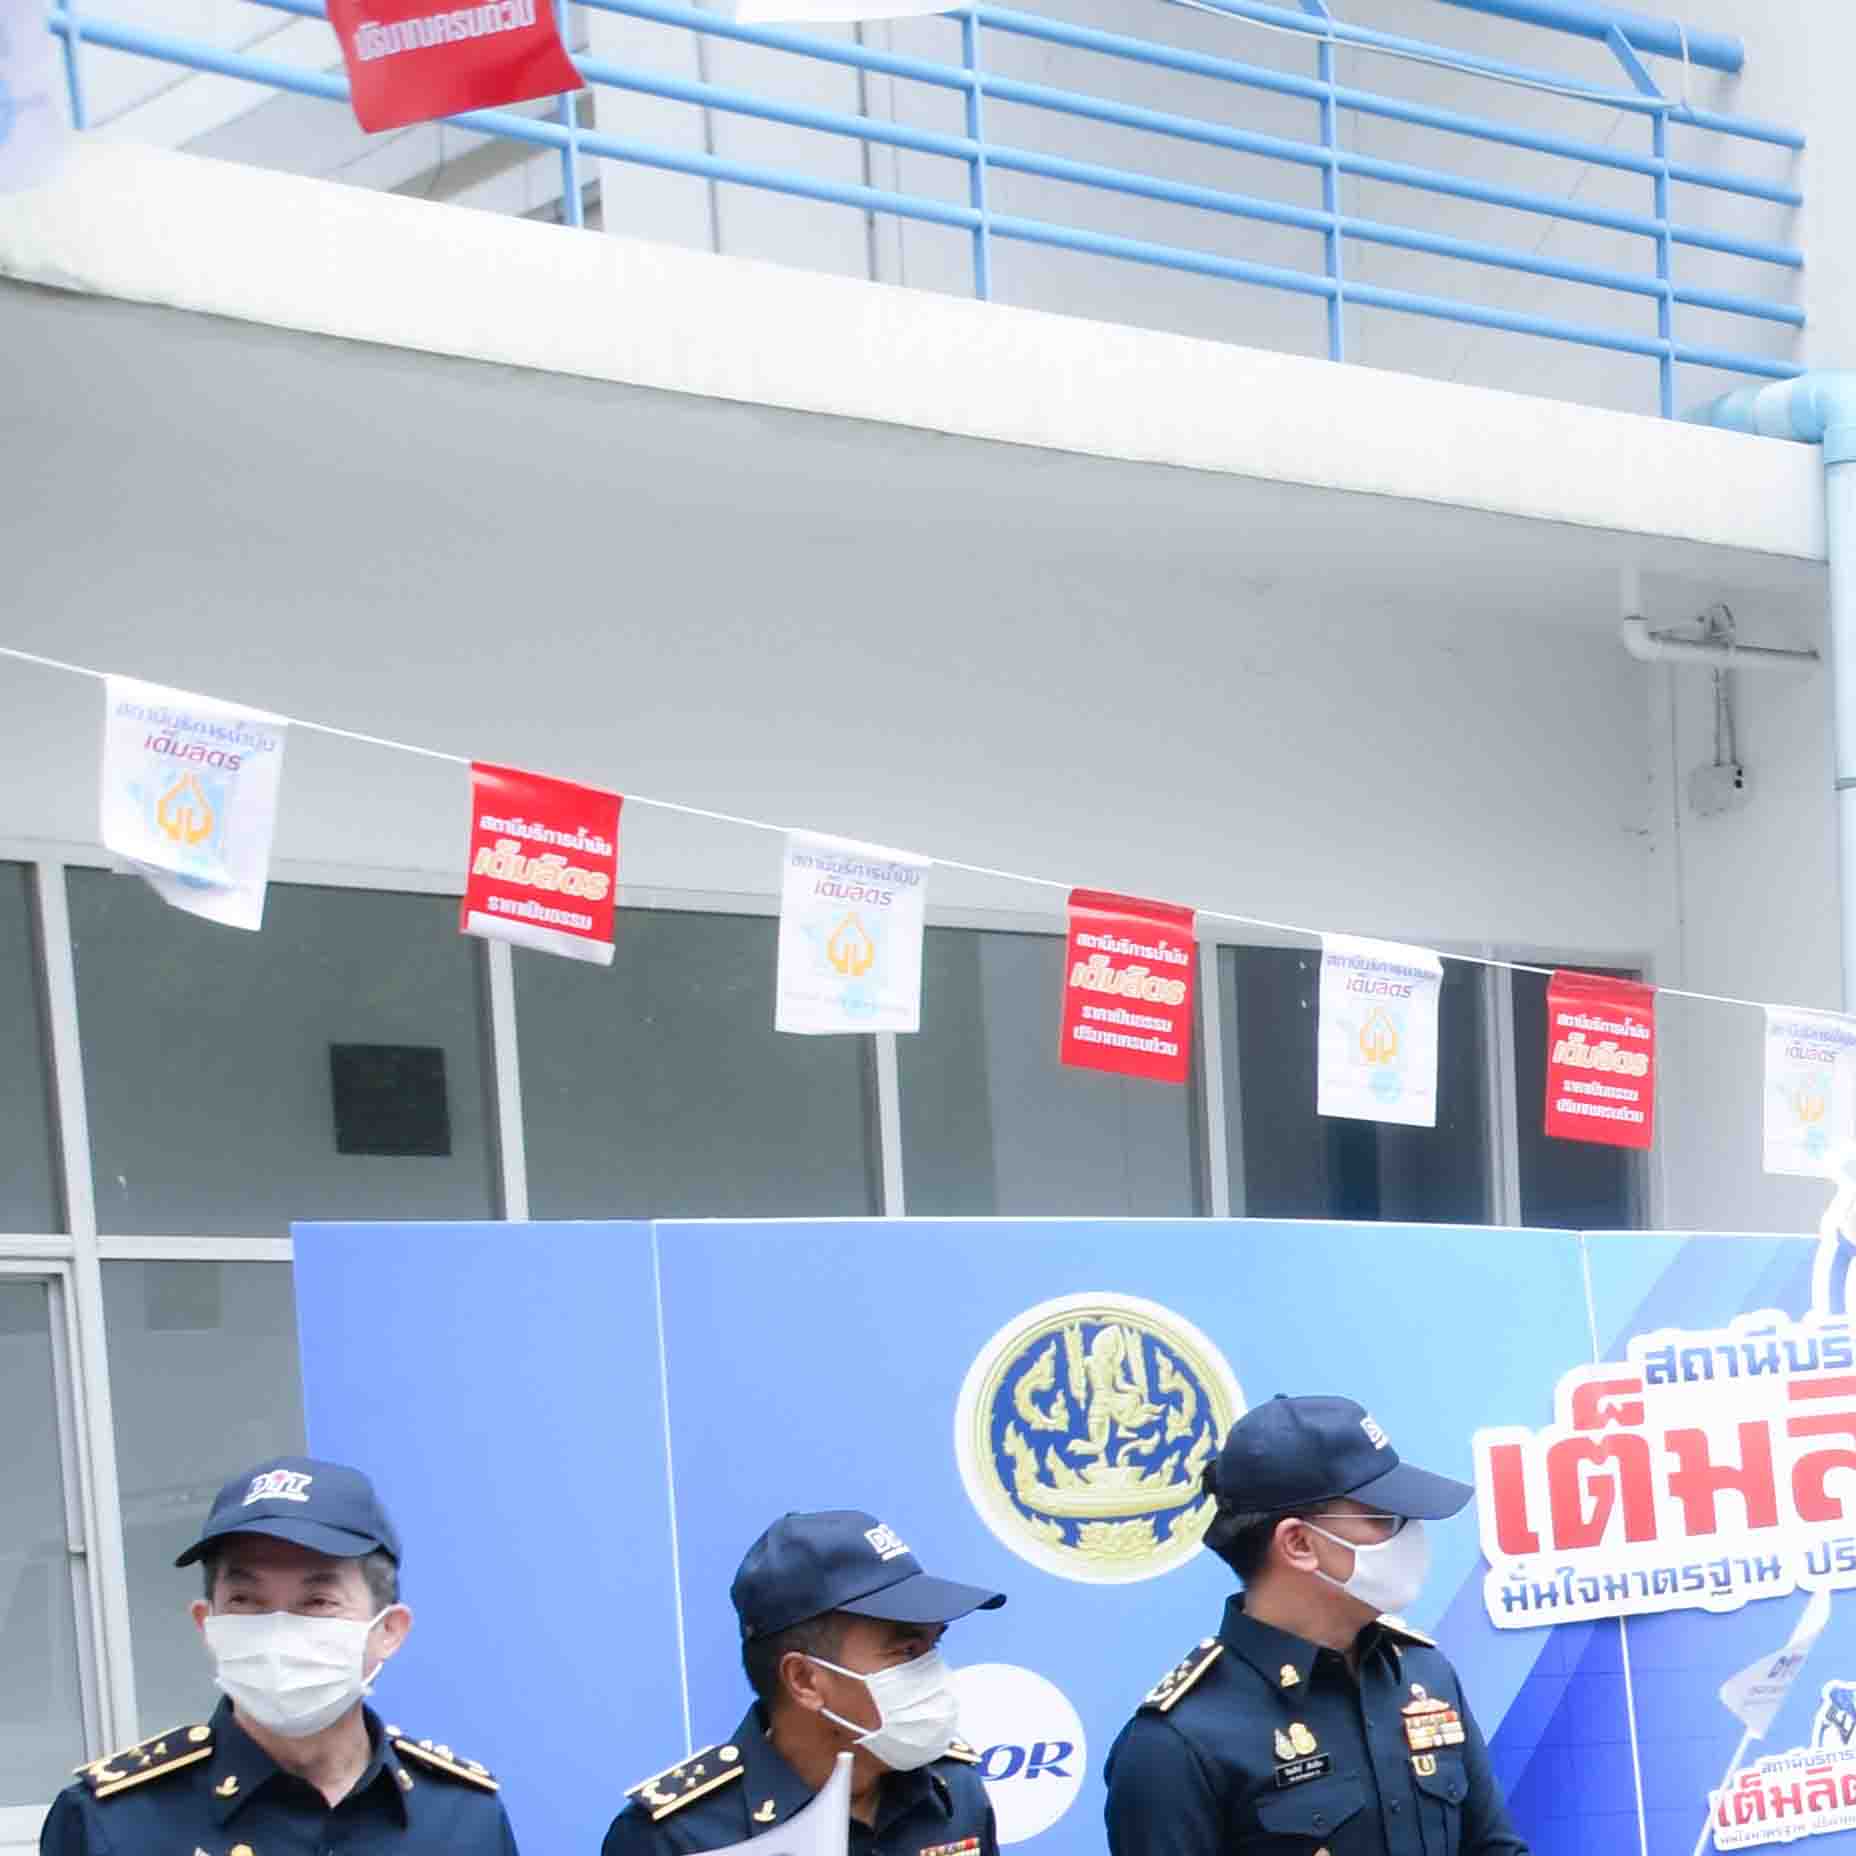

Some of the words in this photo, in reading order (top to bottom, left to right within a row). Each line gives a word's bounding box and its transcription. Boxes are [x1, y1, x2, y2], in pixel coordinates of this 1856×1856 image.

[1501, 1551, 1782, 1612] มั่นใจมาตรฐาน
[977, 1741, 1074, 1782] OR
